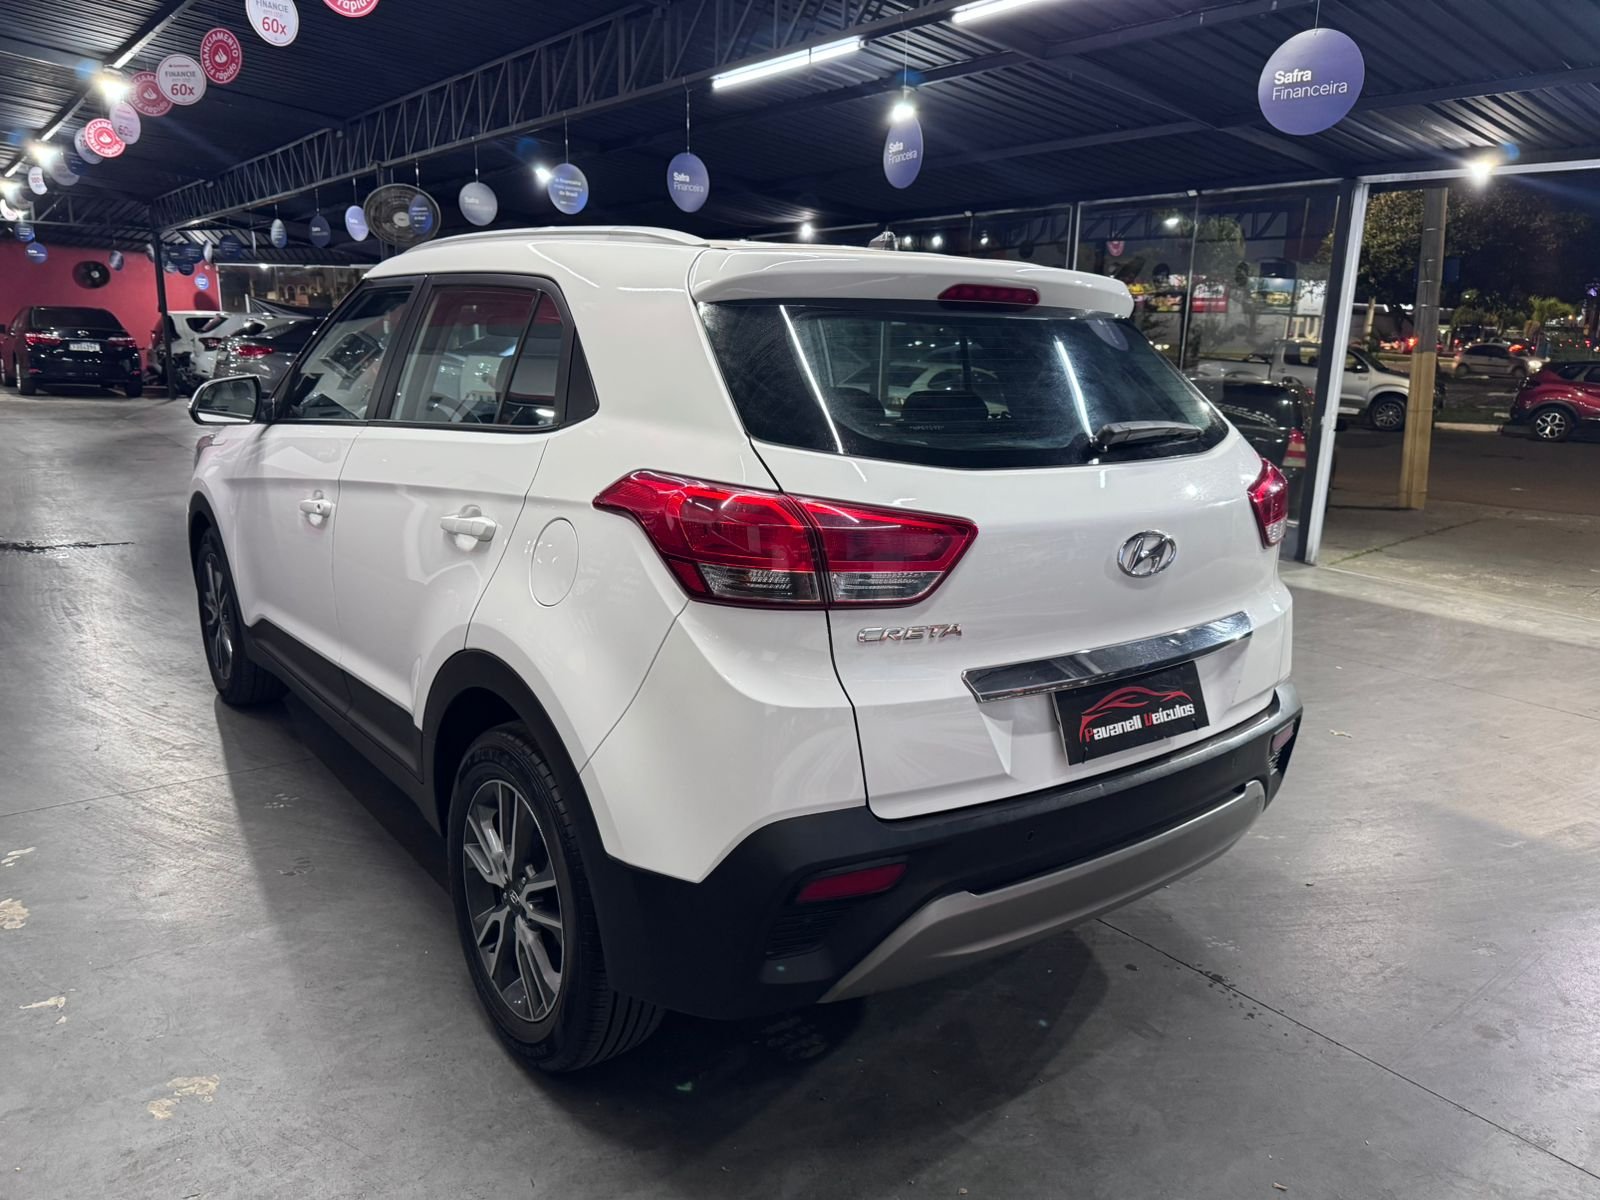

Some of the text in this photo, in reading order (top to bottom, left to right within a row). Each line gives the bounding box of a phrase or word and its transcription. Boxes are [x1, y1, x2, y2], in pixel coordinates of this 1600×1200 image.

[262, 16, 287, 35] 60x
[1274, 68, 1312, 85] Safra
[171, 83, 195, 96] 60x
[1272, 80, 1348, 101] Financeira
[673, 171, 690, 183] Safra
[857, 624, 962, 642] CRETA
[1144, 703, 1195, 727] Veículos
